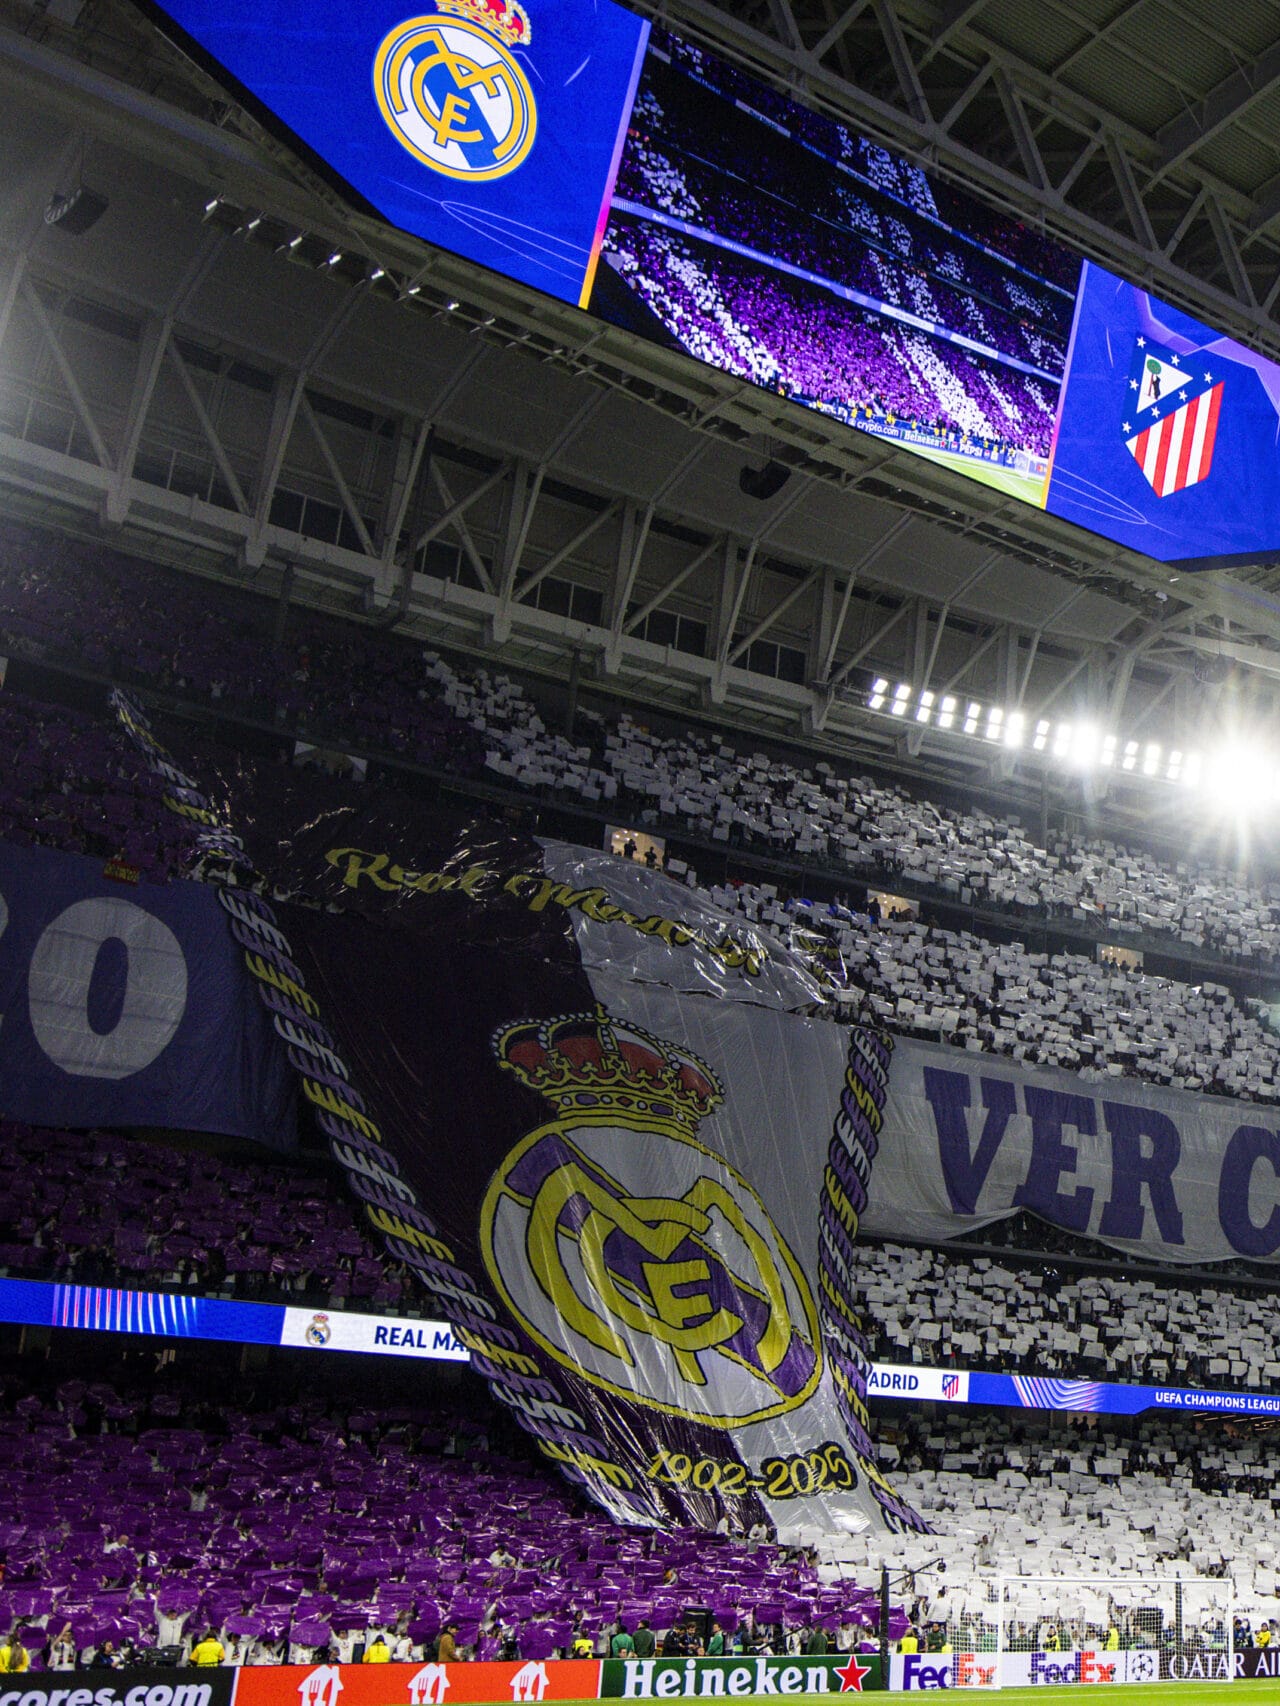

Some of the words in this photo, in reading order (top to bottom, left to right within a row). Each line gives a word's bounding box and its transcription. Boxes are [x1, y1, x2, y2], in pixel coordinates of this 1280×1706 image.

[924, 1066, 1185, 1245] VER
[374, 1325, 427, 1348] REAL
[433, 1331, 467, 1352] MA
[868, 1372, 919, 1390] ADRID
[1155, 1392, 1182, 1404] UEFA
[1184, 1394, 1246, 1409] CHAMPIONS
[646, 1445, 853, 1497] 1902-2025
[621, 1658, 830, 1699] Heineken
[902, 1653, 997, 1691] FedEx
[1030, 1650, 1116, 1684] FedEx
[1169, 1652, 1246, 1680] QATAR
